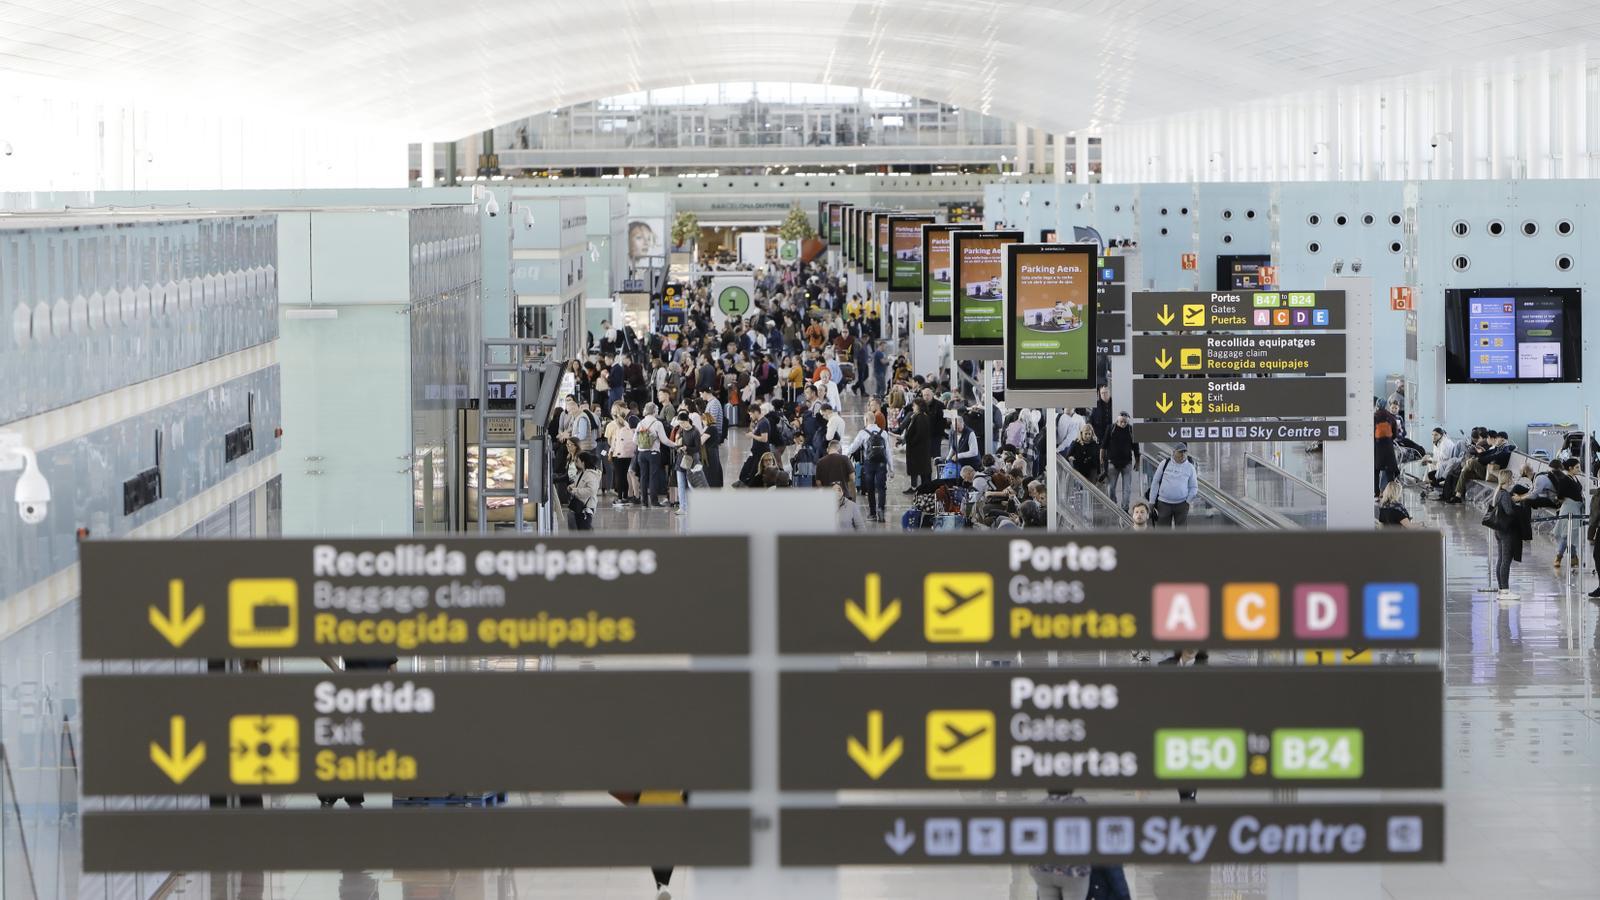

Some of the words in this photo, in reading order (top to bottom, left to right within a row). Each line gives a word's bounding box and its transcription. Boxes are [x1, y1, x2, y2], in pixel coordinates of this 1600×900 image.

[1021, 265, 1055, 274] Parking
[1057, 265, 1082, 273] Aena.
[1211, 293, 1241, 303] Portes
[1211, 305, 1237, 313] Gates
[1256, 295, 1277, 304] B47
[1291, 295, 1312, 304] B24
[1211, 315, 1247, 325] Puertas
[1257, 312, 1267, 323] A
[1277, 311, 1286, 323] C
[1297, 311, 1306, 323] D
[1316, 311, 1325, 323] E
[1207, 337, 1255, 347] Recollida
[1258, 338, 1316, 348] equipatges
[1207, 349, 1243, 358] Baggage
[1245, 349, 1268, 357] claim
[1207, 360, 1256, 370] Recogida
[1259, 360, 1309, 370] equipajes
[1207, 381, 1246, 391] Sortida
[1207, 393, 1223, 402] Exit
[1208, 403, 1240, 413] Salida
[1249, 426, 1273, 439] Sky
[1277, 426, 1321, 437] Centre
[313, 544, 464, 577] Recollida
[475, 544, 656, 580] equipatges
[1009, 539, 1117, 572] Portes
[313, 580, 428, 613] Baggage
[435, 580, 506, 608] claim
[1009, 575, 1085, 605] Gates
[1009, 607, 1137, 639] Puertas
[1165, 592, 1197, 632] A
[1235, 591, 1267, 632] C
[1306, 591, 1338, 631] D
[1377, 591, 1405, 631] E
[314, 612, 468, 649] Recogida
[477, 611, 636, 648] equipajes
[314, 681, 435, 714] Sortida
[1010, 677, 1119, 710] Portes
[314, 717, 363, 746] Exit
[1010, 712, 1086, 743] Gates
[315, 749, 417, 781] Salida
[1011, 745, 1138, 777] Puertas
[1164, 735, 1237, 772] B50
[1247, 733, 1271, 755] to
[1281, 736, 1354, 771] B24
[1250, 754, 1267, 776] a
[1140, 816, 1217, 861] Sky
[1229, 815, 1367, 854] Centre
